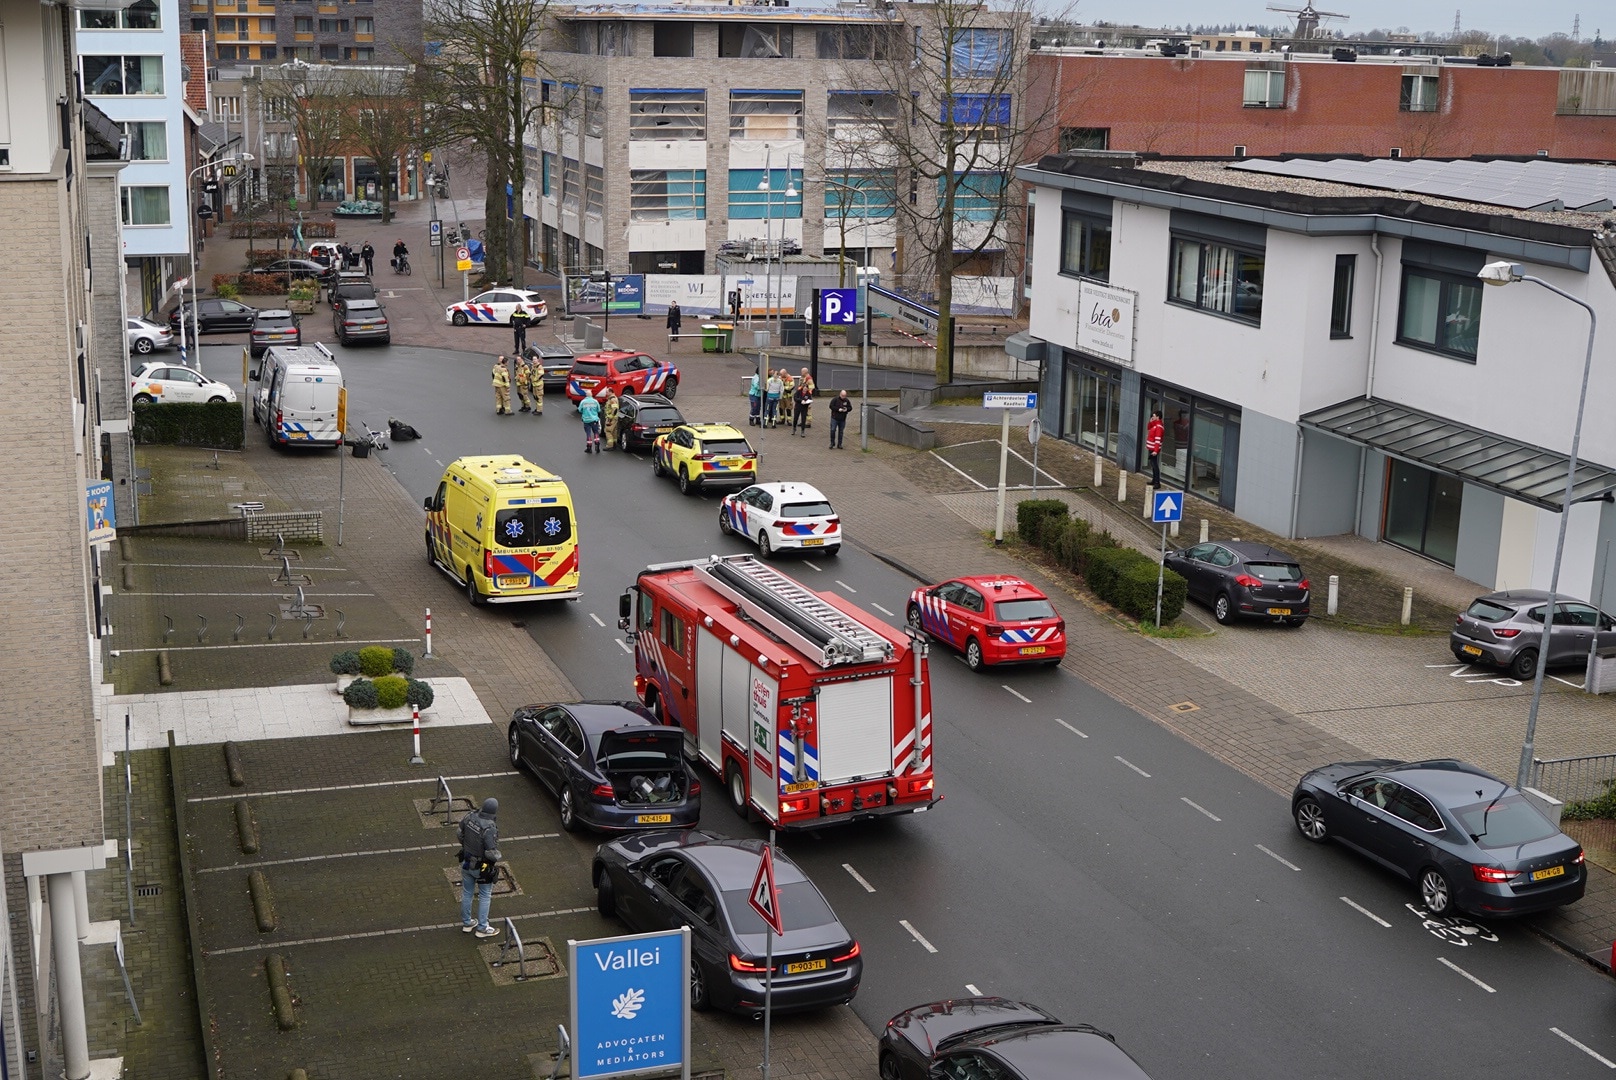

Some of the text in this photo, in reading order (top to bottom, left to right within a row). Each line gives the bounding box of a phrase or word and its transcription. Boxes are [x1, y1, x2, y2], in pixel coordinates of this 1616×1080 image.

[688, 283, 704, 294] WJ
[826, 297, 841, 322] P
[1091, 302, 1113, 328] bta
[91, 485, 110, 496] KOOP
[754, 678, 770, 699] Oefen
[753, 689, 767, 709] thuis
[1535, 867, 1561, 879] L-174-GB
[594, 947, 660, 971] Vallei
[791, 960, 824, 972] P-903-TL
[597, 1034, 665, 1049] ADVOCATEN
[597, 1051, 665, 1066] MEDIATORS
